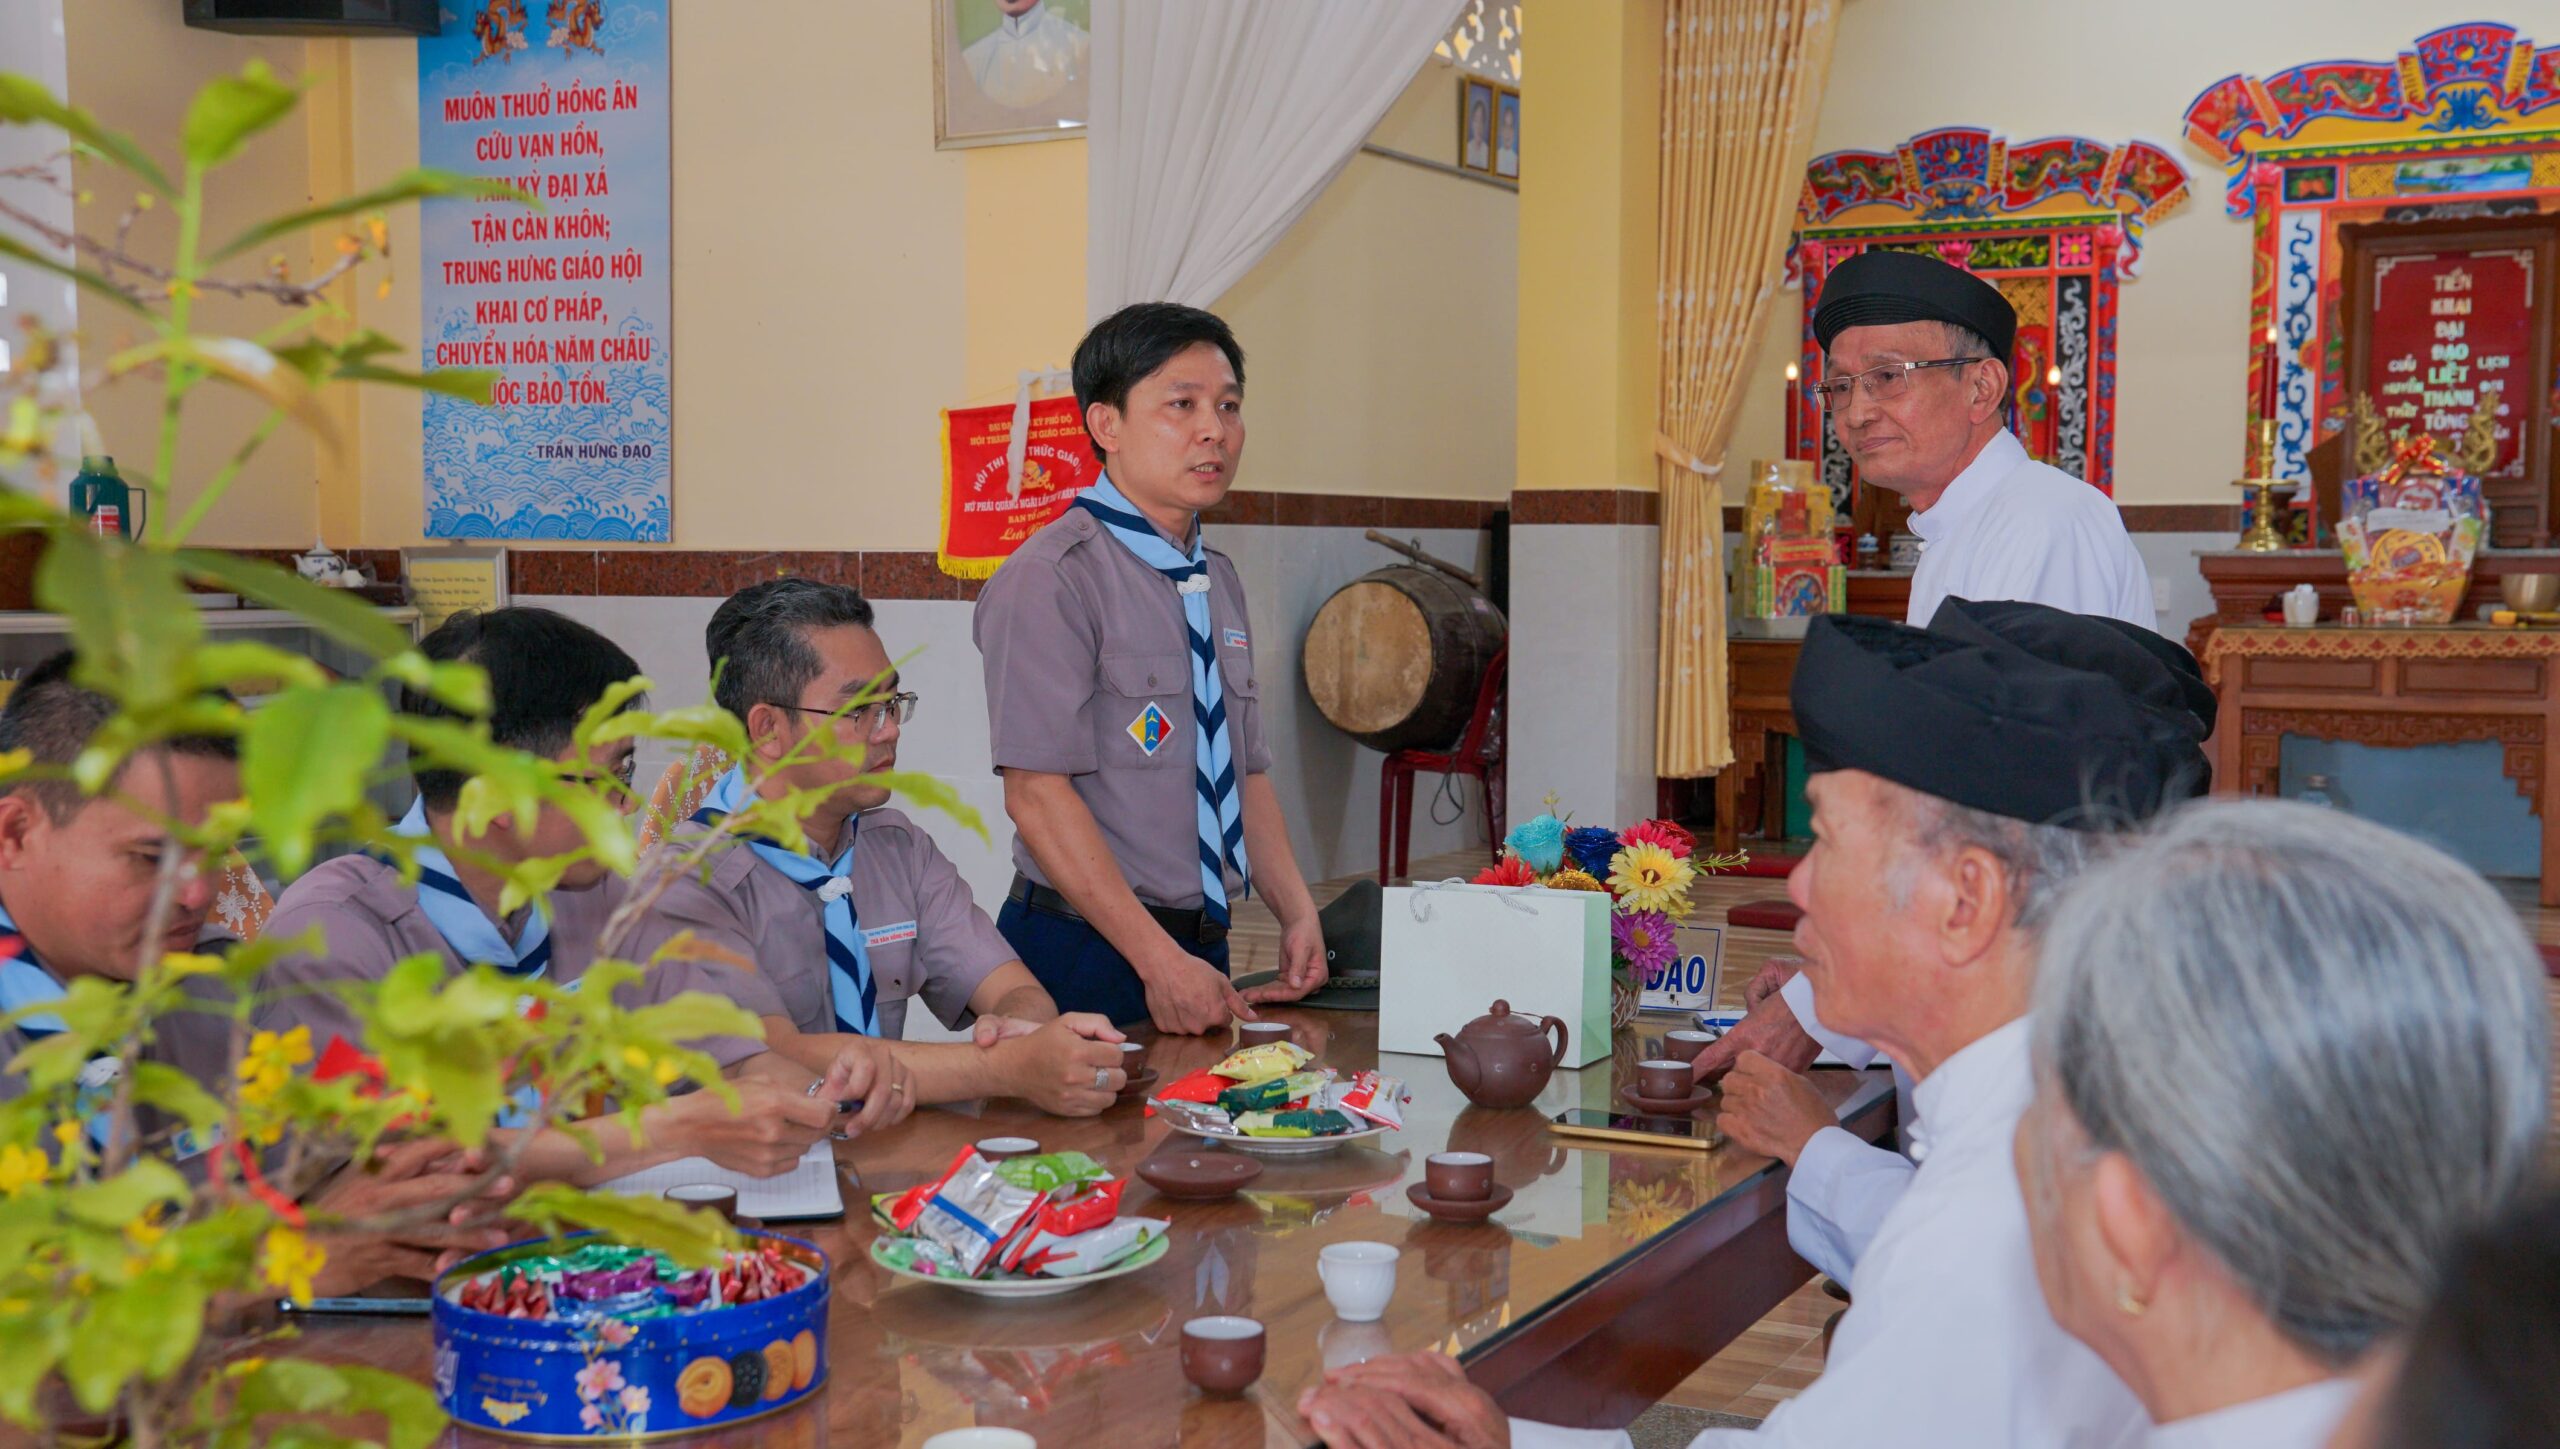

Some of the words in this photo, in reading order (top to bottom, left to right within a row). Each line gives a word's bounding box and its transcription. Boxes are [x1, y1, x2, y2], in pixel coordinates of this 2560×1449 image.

[444, 91, 496, 122] MUÔN
[501, 82, 551, 118] THUỞ
[556, 79, 607, 114] HỒNG
[612, 80, 638, 110] ÂN
[476, 130, 513, 161] CỨU
[519, 134, 554, 163] VẠN
[560, 121, 604, 158] HỒN,
[518, 170, 542, 200] KỲ
[548, 173, 578, 203] ĐẠI
[585, 165, 609, 196] XÁ
[471, 213, 506, 248] TẬN
[512, 211, 548, 242] CÀN
[554, 208, 611, 242] KHÔN;
[443, 260, 502, 285] TRUNG
[507, 255, 557, 282] HƯNG
[562, 250, 604, 280] GIÁO
[611, 248, 642, 284] HỘI
[476, 301, 518, 325] KHAI
[524, 296, 549, 323] CƠ
[554, 291, 608, 326] PHÁP,
[2430, 297, 2473, 316] KHAI
[436, 329, 506, 366] CHUYỂN
[513, 334, 549, 364] HÓA
[555, 335, 594, 364] NĂM
[601, 331, 650, 362] CHÂU
[476, 376, 521, 411] UỘC
[527, 372, 564, 405] BẢO
[569, 370, 611, 406] TỒN.
[536, 439, 573, 460] TRẦN
[578, 441, 618, 459] HƯNG
[622, 444, 651, 462] ĐẠO
[973, 469, 988, 492] HỘI
[986, 456, 1005, 473] THI
[1008, 514, 1026, 524] BAN
